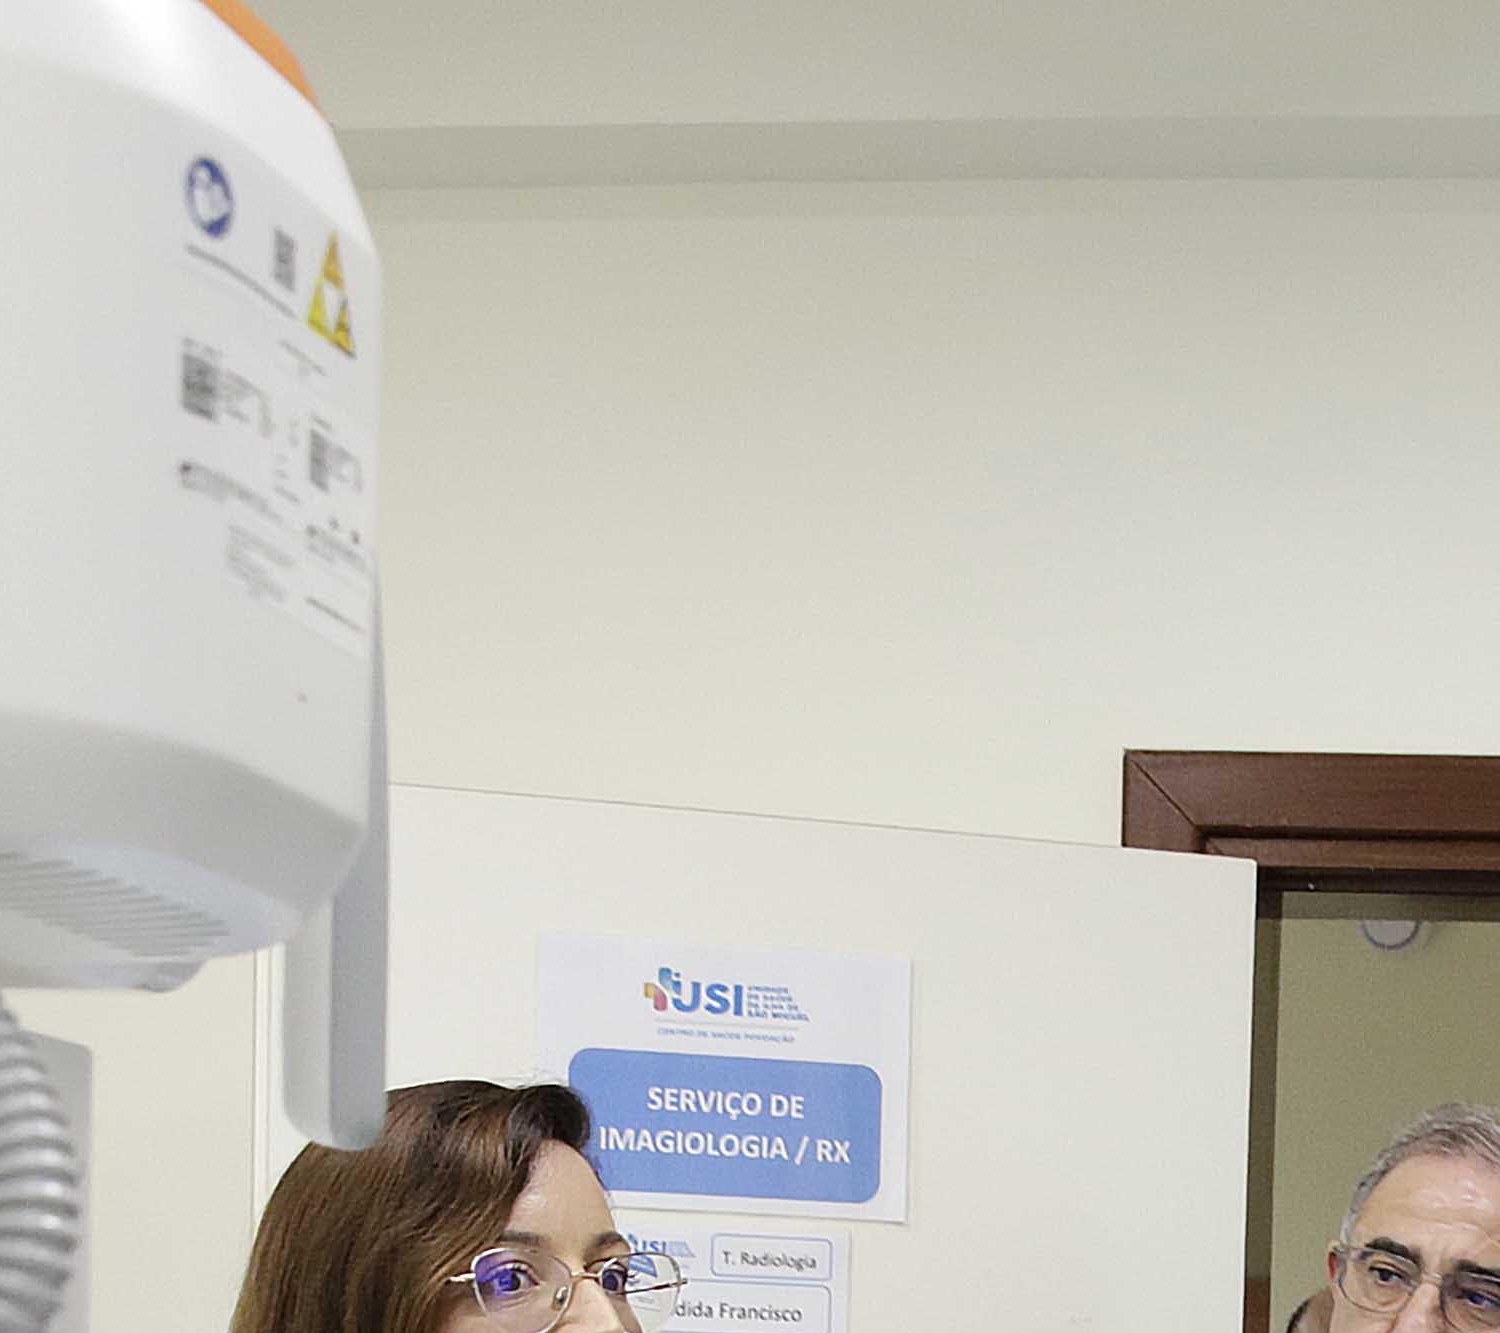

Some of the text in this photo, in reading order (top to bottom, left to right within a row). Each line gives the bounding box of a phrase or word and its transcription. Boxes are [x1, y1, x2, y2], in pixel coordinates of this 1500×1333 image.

[647, 1087, 805, 1120] SERVIÇO DE
[600, 1126, 851, 1165] IMAGIOLOGIA / RX
[722, 1250, 817, 1272] T. Radiologia
[675, 1301, 803, 1322] dida Francisco
